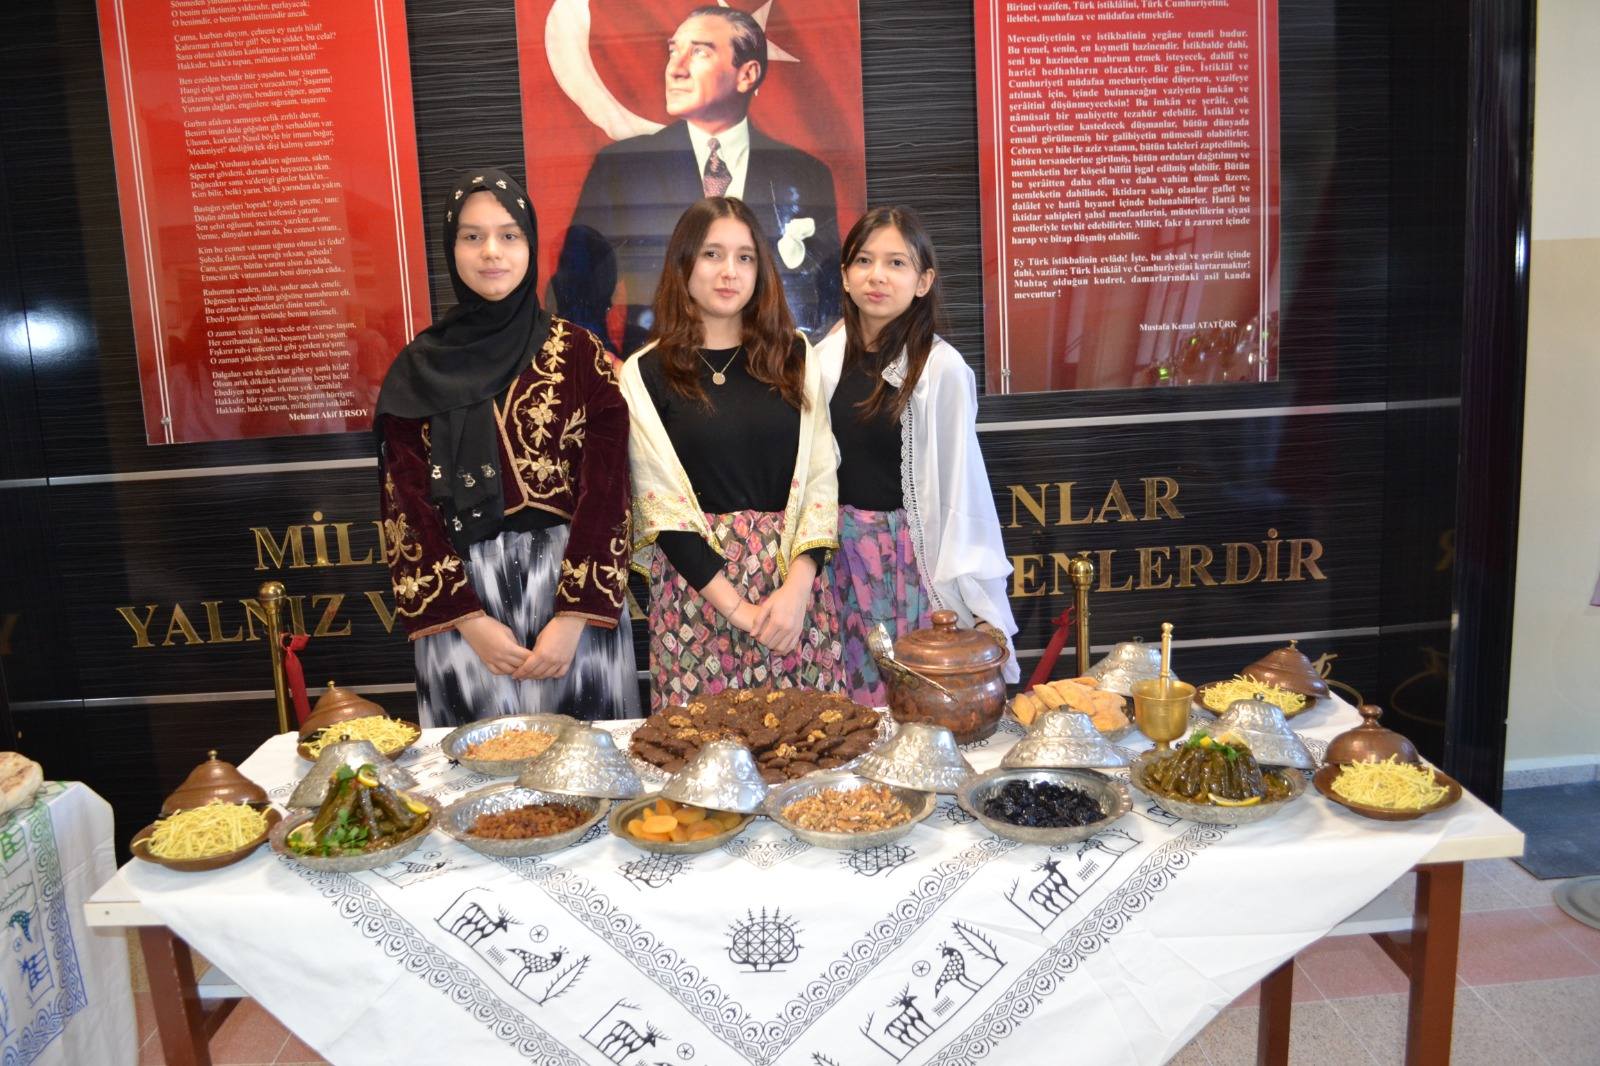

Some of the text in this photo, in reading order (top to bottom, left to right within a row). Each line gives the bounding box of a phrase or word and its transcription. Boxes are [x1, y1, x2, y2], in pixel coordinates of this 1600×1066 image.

[1006, 3, 1036, 11] Birinci
[1041, 13, 1084, 22] muhafaza
[1187, 30, 1214, 38] temeli
[1029, 57, 1041, 65] bu
[1045, 56, 1089, 64] hazineden
[1094, 55, 1131, 63] mahrum
[1135, 54, 1161, 62] etmek
[1072, 89, 1099, 99] içinde
[1162, 86, 1201, 96] vaziyetin
[1056, 112, 1070, 120] bir
[1075, 111, 1119, 121] mahiyette
[1010, 147, 1042, 155] Cebren
[1073, 145, 1084, 153] ile
[1166, 142, 1198, 150] kaleleri
[1070, 178, 1092, 186] daha
[1162, 175, 1188, 183] vahim
[1119, 199, 1145, 208] içinde
[1011, 236, 1037, 246] harap
[1013, 259, 1025, 268] Ey
[1164, 253, 1187, 261] ahval
[1227, 251, 1251, 260] içinde
[1014, 279, 1048, 289] Muhtaç
[1052, 278, 1089, 288] olduğun
[1204, 273, 1219, 281] asil
[1224, 272, 1251, 280] kanda
[1014, 290, 1057, 298] mevcuttur
[1139, 319, 1237, 331] Mustafa Kemal ATATÜRK
[288, 413, 319, 421] Mehmet
[338, 409, 369, 417] ERSOY
[1001, 477, 1185, 529] NLAR
